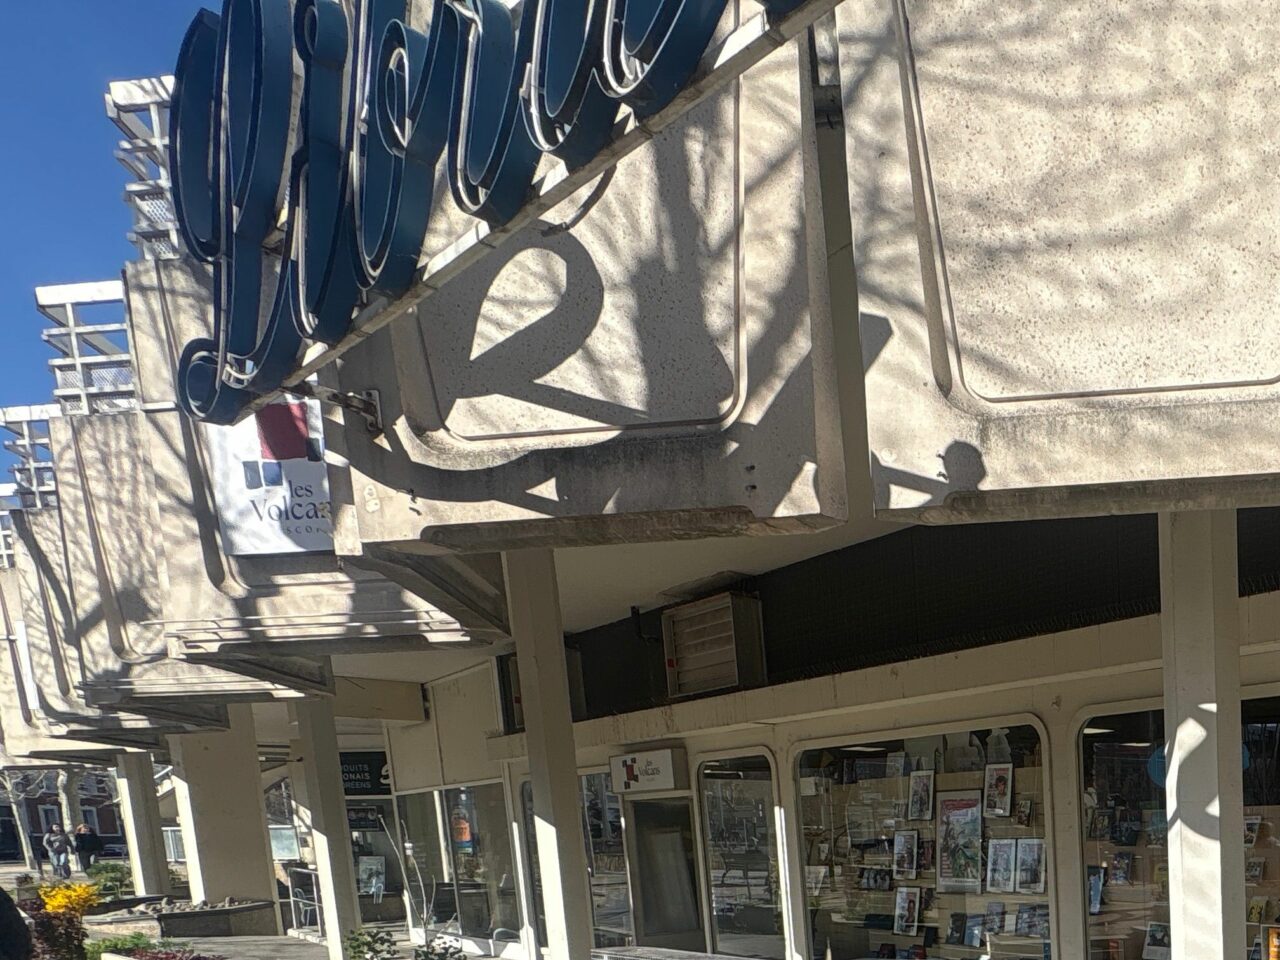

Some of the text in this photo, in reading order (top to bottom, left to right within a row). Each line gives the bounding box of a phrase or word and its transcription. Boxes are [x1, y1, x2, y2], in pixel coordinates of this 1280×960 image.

[288, 479, 314, 498] les
[249, 495, 332, 522] Volca
[343, 764, 369, 772] DUITS
[342, 772, 371, 780] ONAIS
